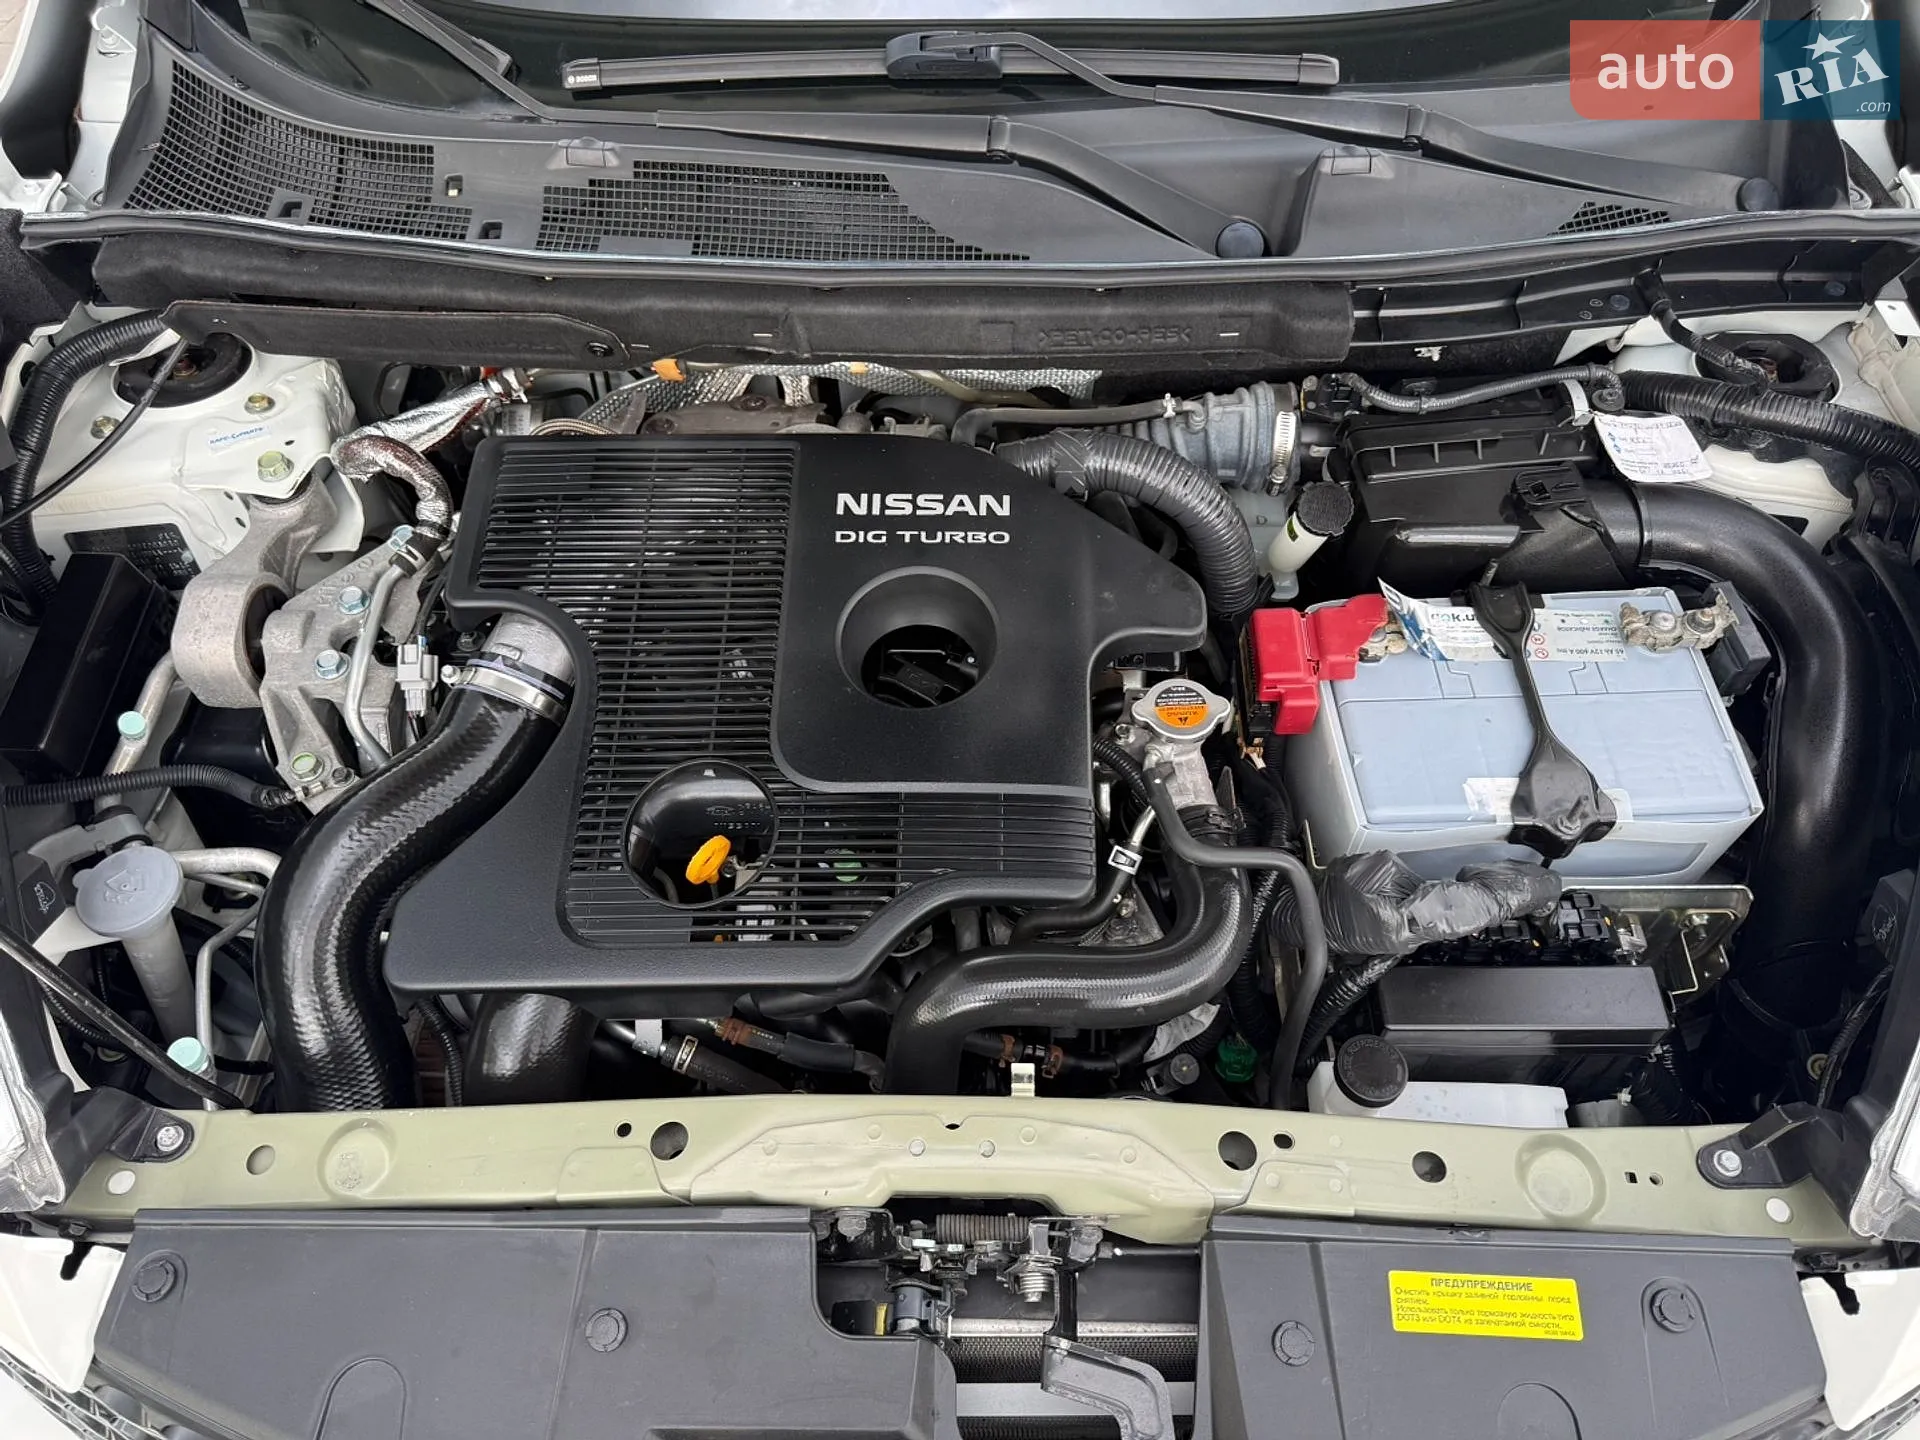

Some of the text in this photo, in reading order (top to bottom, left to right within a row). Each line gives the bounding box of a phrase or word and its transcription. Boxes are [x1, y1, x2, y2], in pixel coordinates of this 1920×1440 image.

[836, 493, 1011, 516] NISSAN
[835, 531, 1011, 544] DIG TURBO
[1431, 1278, 1533, 1291] ПРЕДУПРЕЖДЕНИЕ
[1394, 1287, 1430, 1296] Очистить
[1397, 1313, 1421, 1322] DOT3
[1438, 1315, 1461, 1324] DOT4
